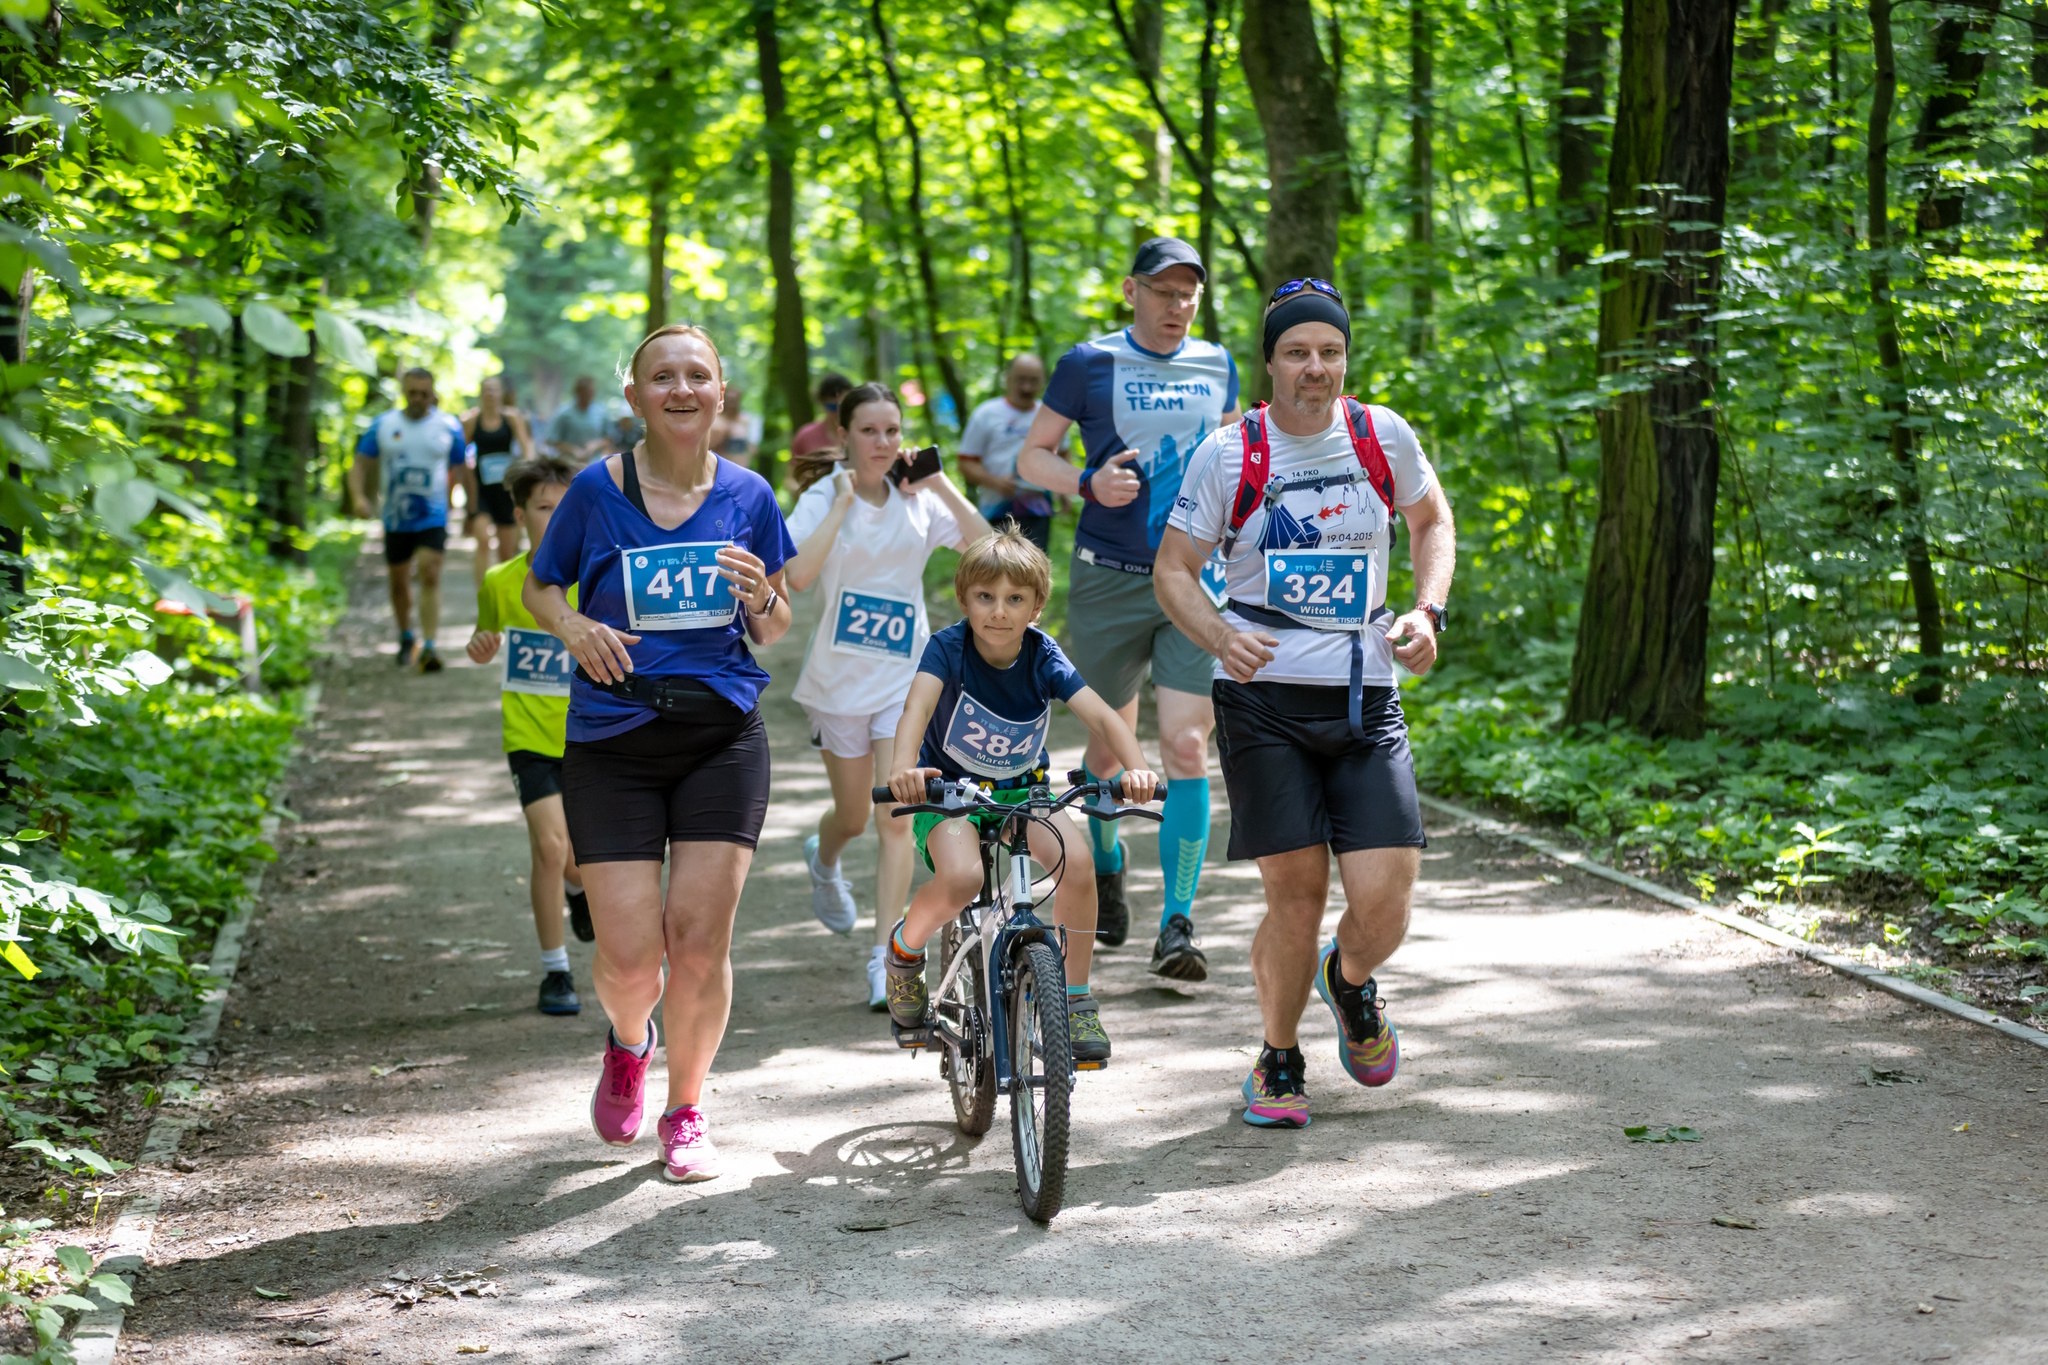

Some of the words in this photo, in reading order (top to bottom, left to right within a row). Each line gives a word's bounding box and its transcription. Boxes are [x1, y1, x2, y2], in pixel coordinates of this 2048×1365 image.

[1124, 382, 1167, 394] CITY
[1174, 384, 1211, 397] RUN
[1126, 397, 1184, 411] TEAM
[1327, 532, 1373, 543] 19.04.2015
[1124, 564, 1149, 575] PKO
[647, 566, 720, 599] 417
[1283, 574, 1355, 604] 324
[679, 600, 697, 609] Ela
[1300, 606, 1336, 615] Witold
[847, 609, 906, 641] 270
[517, 646, 570, 673] 271
[962, 721, 1033, 757] 284
[976, 752, 1011, 766] Marek
